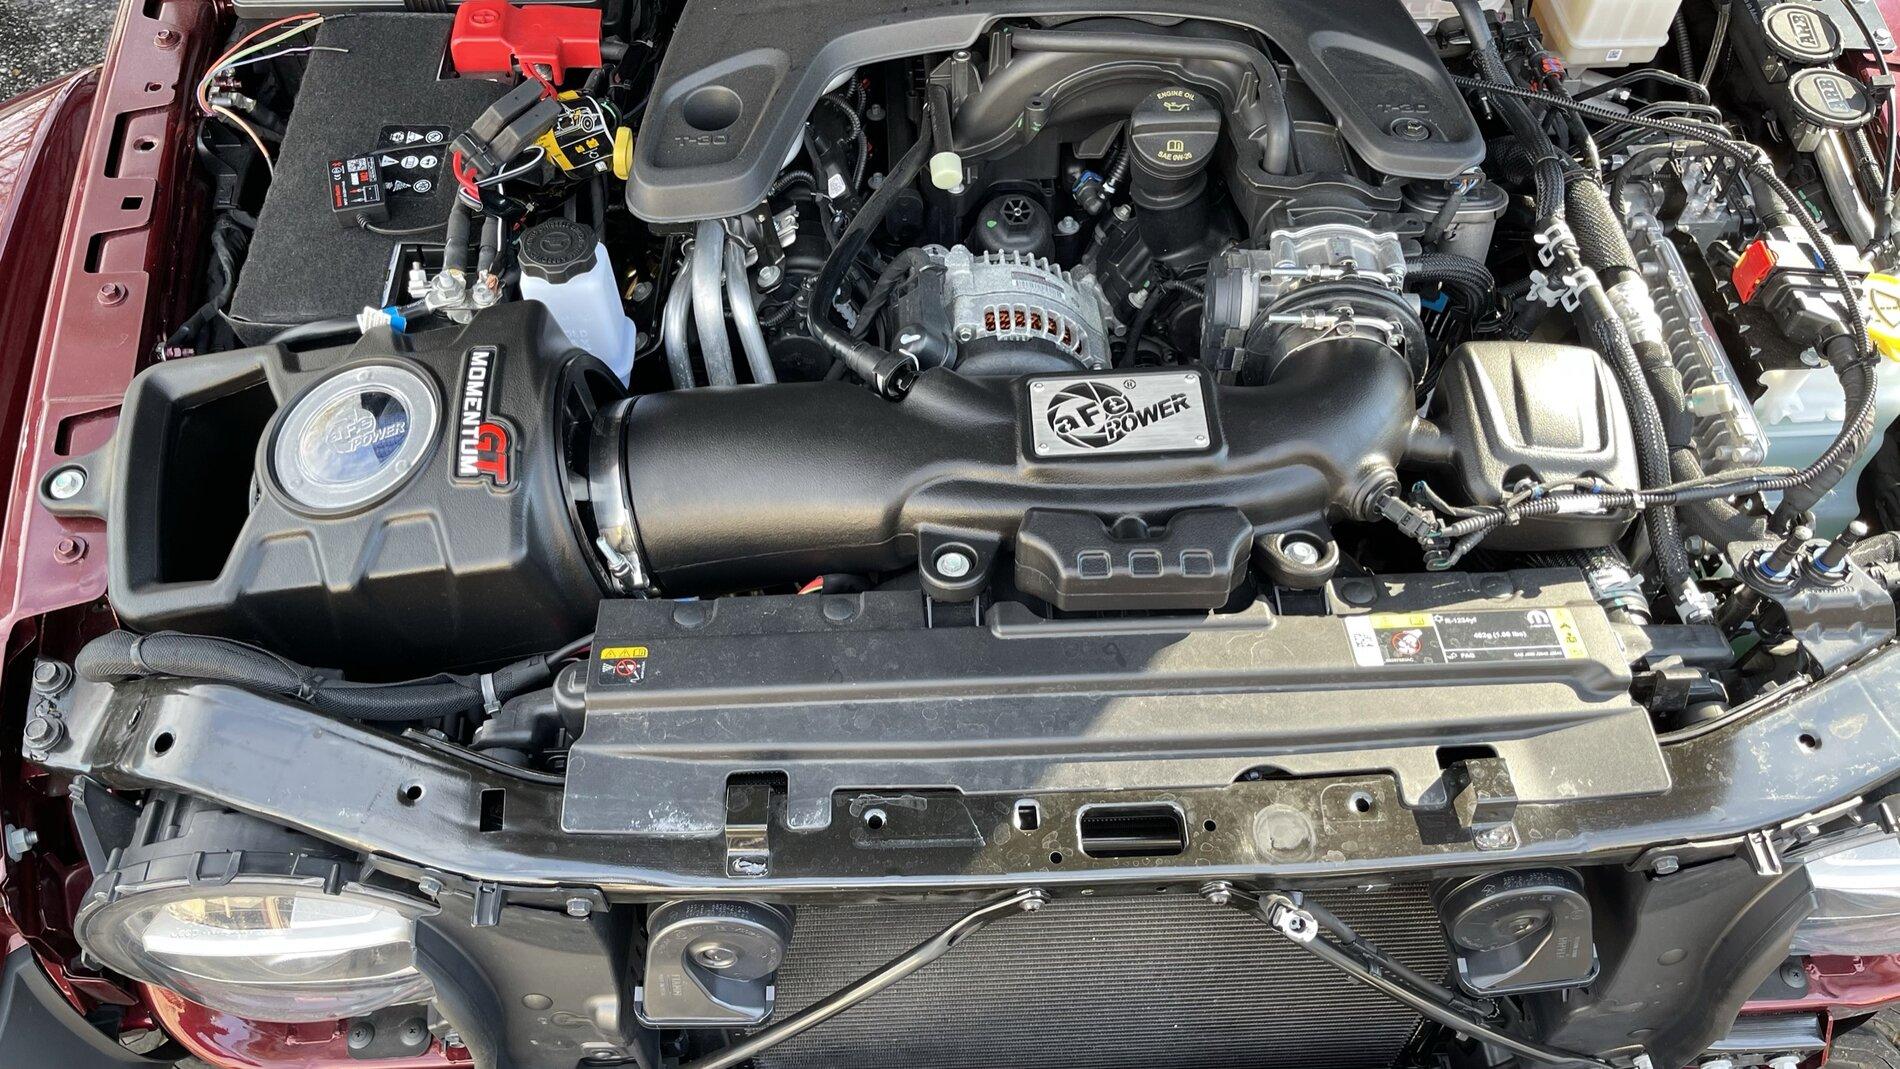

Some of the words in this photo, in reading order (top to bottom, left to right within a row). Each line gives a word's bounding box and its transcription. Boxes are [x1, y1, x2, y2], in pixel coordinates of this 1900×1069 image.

[1157, 90, 1183, 100] ENGINE
[1184, 92, 1195, 101] OIL
[1157, 151, 1172, 160] SAE
[460, 351, 490, 475] MOMENTUM
[1054, 396, 1128, 434] aFe
[1105, 393, 1191, 443] POWER
[348, 421, 405, 452] POWER
[475, 422, 508, 484] GT
